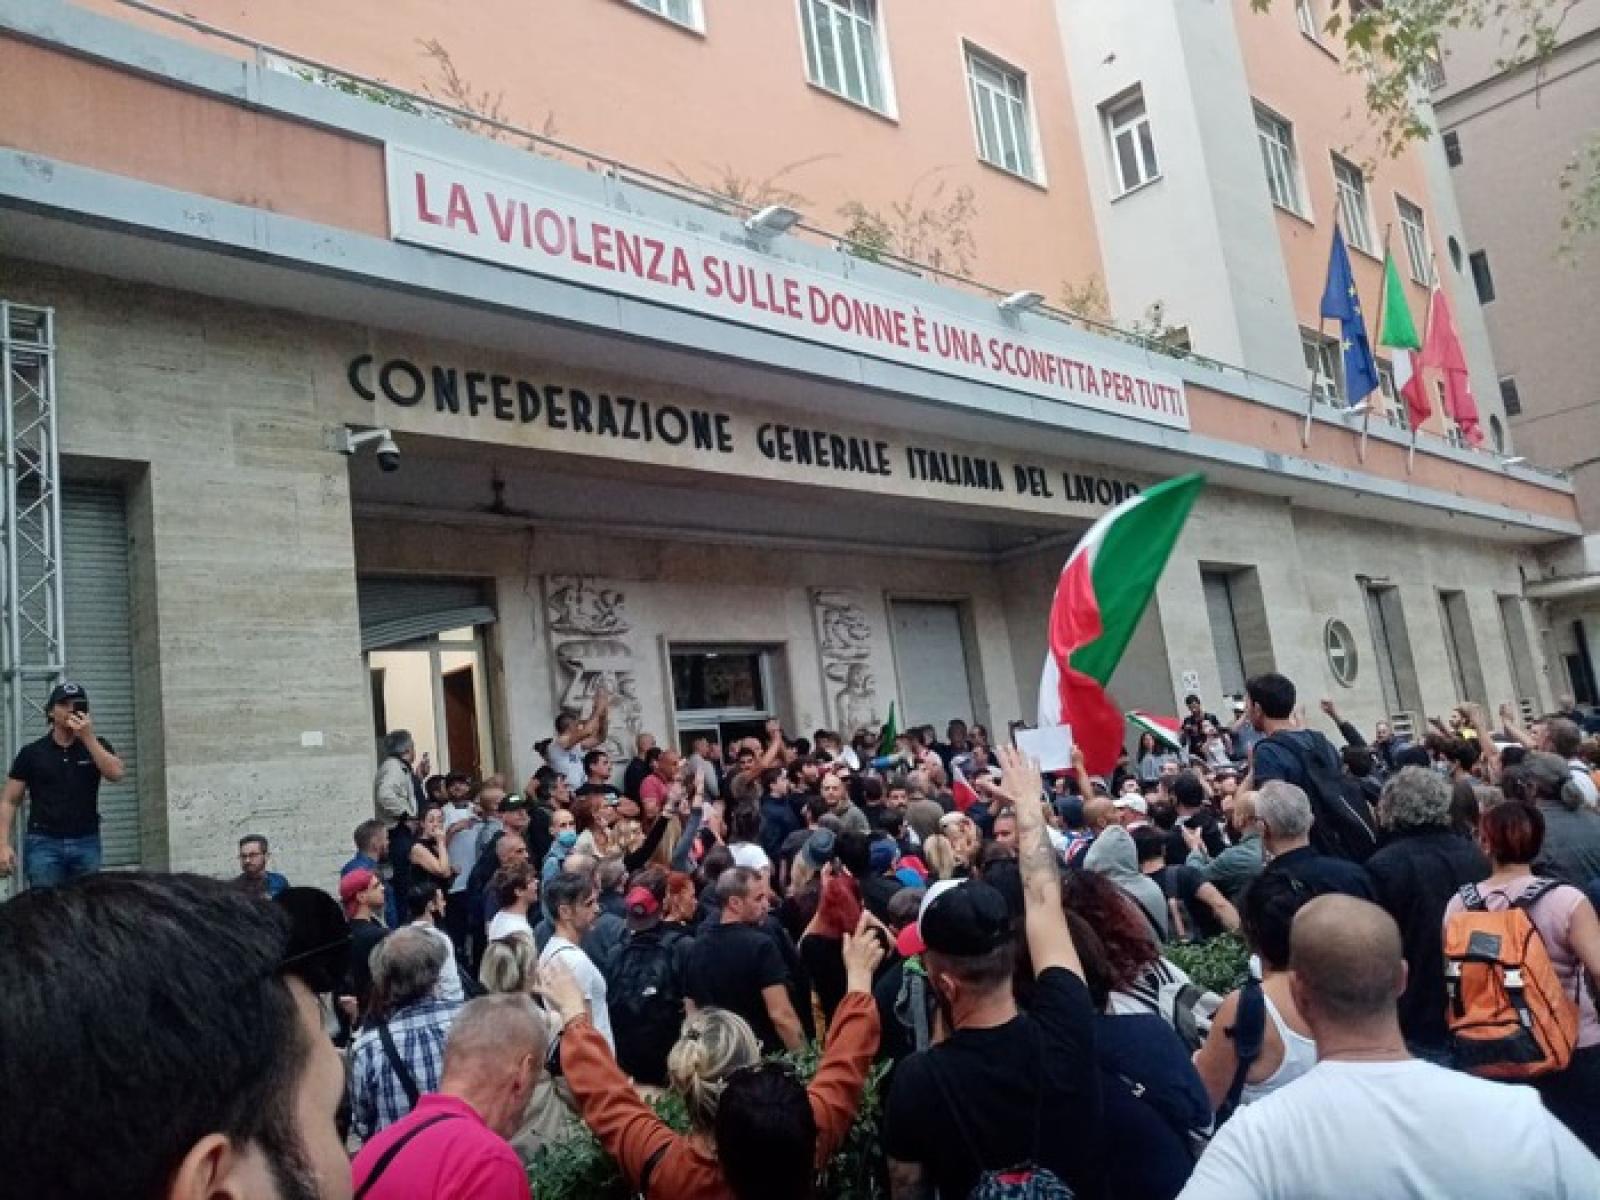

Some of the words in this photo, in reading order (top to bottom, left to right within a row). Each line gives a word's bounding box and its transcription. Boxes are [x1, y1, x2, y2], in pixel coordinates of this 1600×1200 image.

[415, 173, 478, 235] LA
[485, 191, 695, 291] VIOLENZA
[703, 256, 803, 319] SULLE
[808, 286, 908, 348] DONNE
[913, 307, 929, 352] È
[933, 323, 986, 366] UNA
[988, 341, 1100, 396] SCONFITTA
[1101, 368, 1136, 405] PER
[1135, 378, 1185, 416] TUTTI
[347, 354, 733, 453] CONFEDERAZIONE
[757, 423, 892, 476] GENERALE
[906, 447, 1004, 492] ITALIANA
[1013, 463, 1054, 498] DEL
